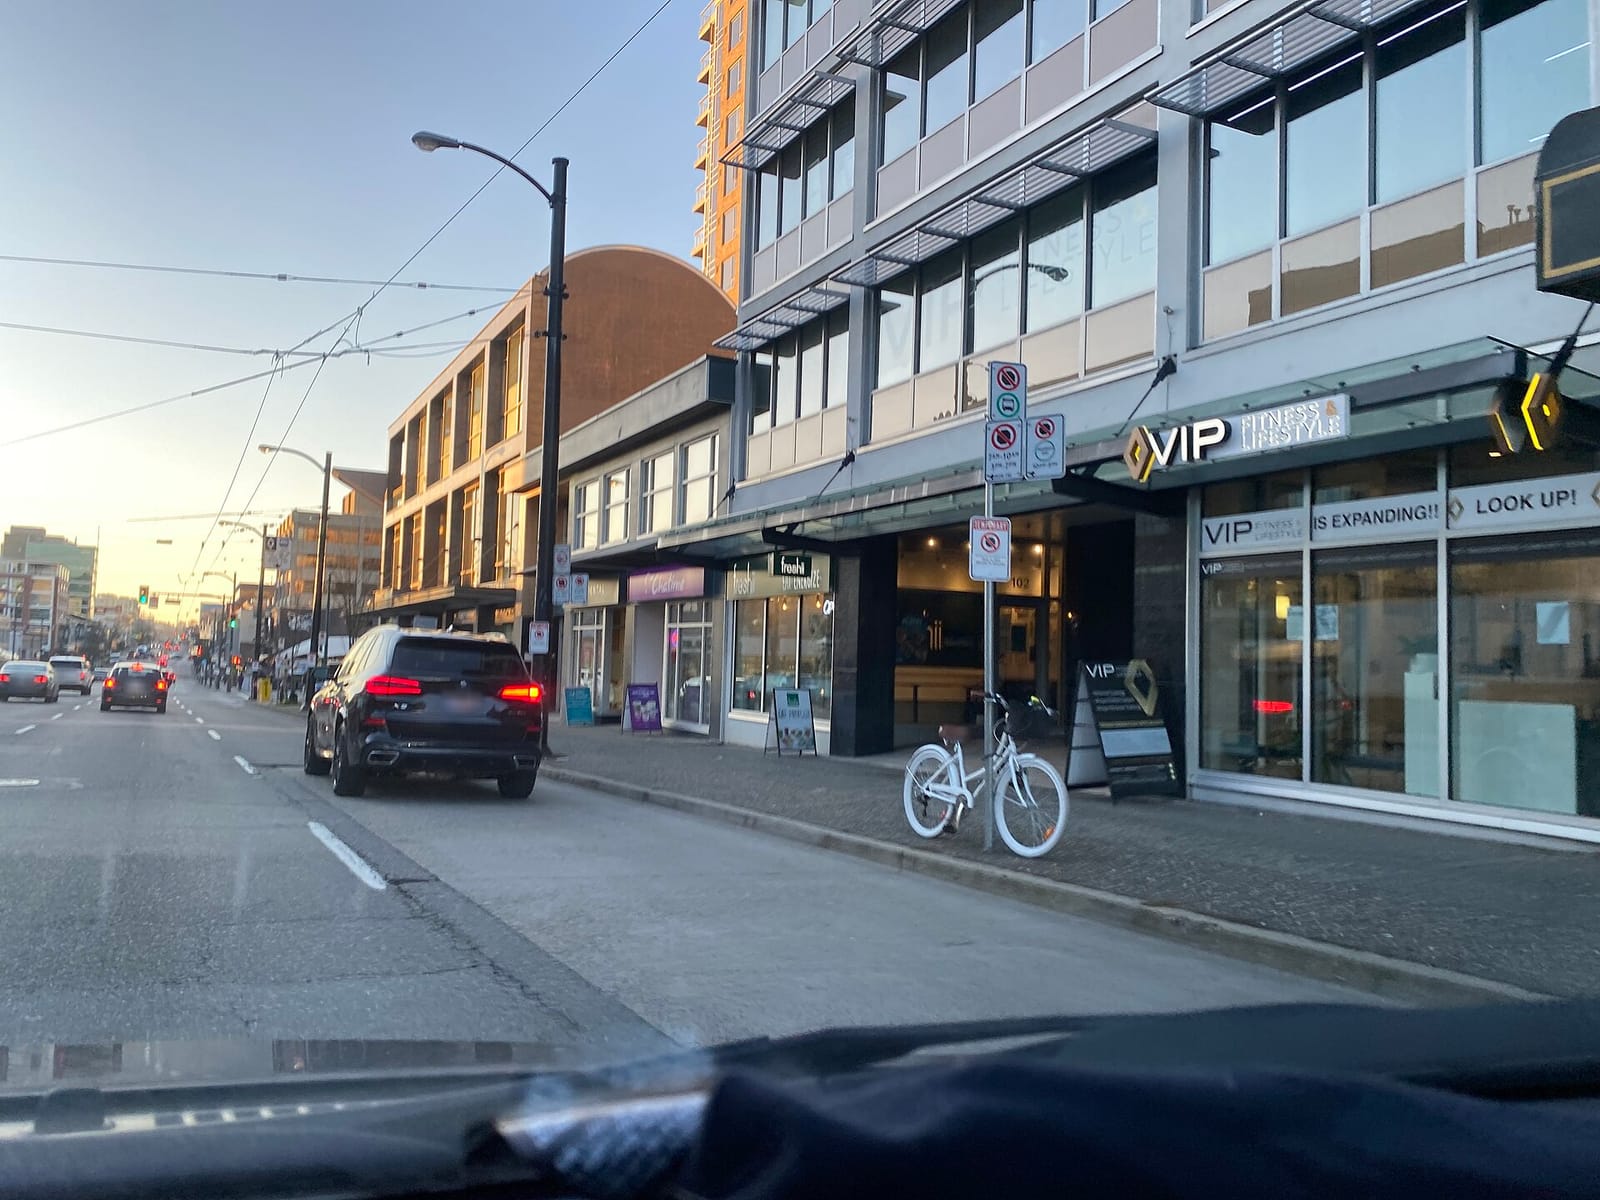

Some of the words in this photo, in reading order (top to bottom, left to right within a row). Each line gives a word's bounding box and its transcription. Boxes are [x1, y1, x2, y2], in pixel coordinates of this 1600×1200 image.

[1241, 402, 1320, 432] FITNESS
[1147, 418, 1228, 466] VIP
[1241, 415, 1341, 449] LIFESTYLE
[1477, 493, 1534, 514] LOOK
[1540, 490, 1577, 508] UP!
[1255, 519, 1295, 530] FITNESS
[1313, 517, 1327, 530] IS
[1331, 502, 1439, 528] EXPANDING!!
[1205, 520, 1253, 545] VIP
[1255, 529, 1304, 541] LIFESTYLE
[1201, 561, 1222, 575] VIP
[1012, 577, 1030, 589] 102
[1085, 663, 1115, 678] VIP
